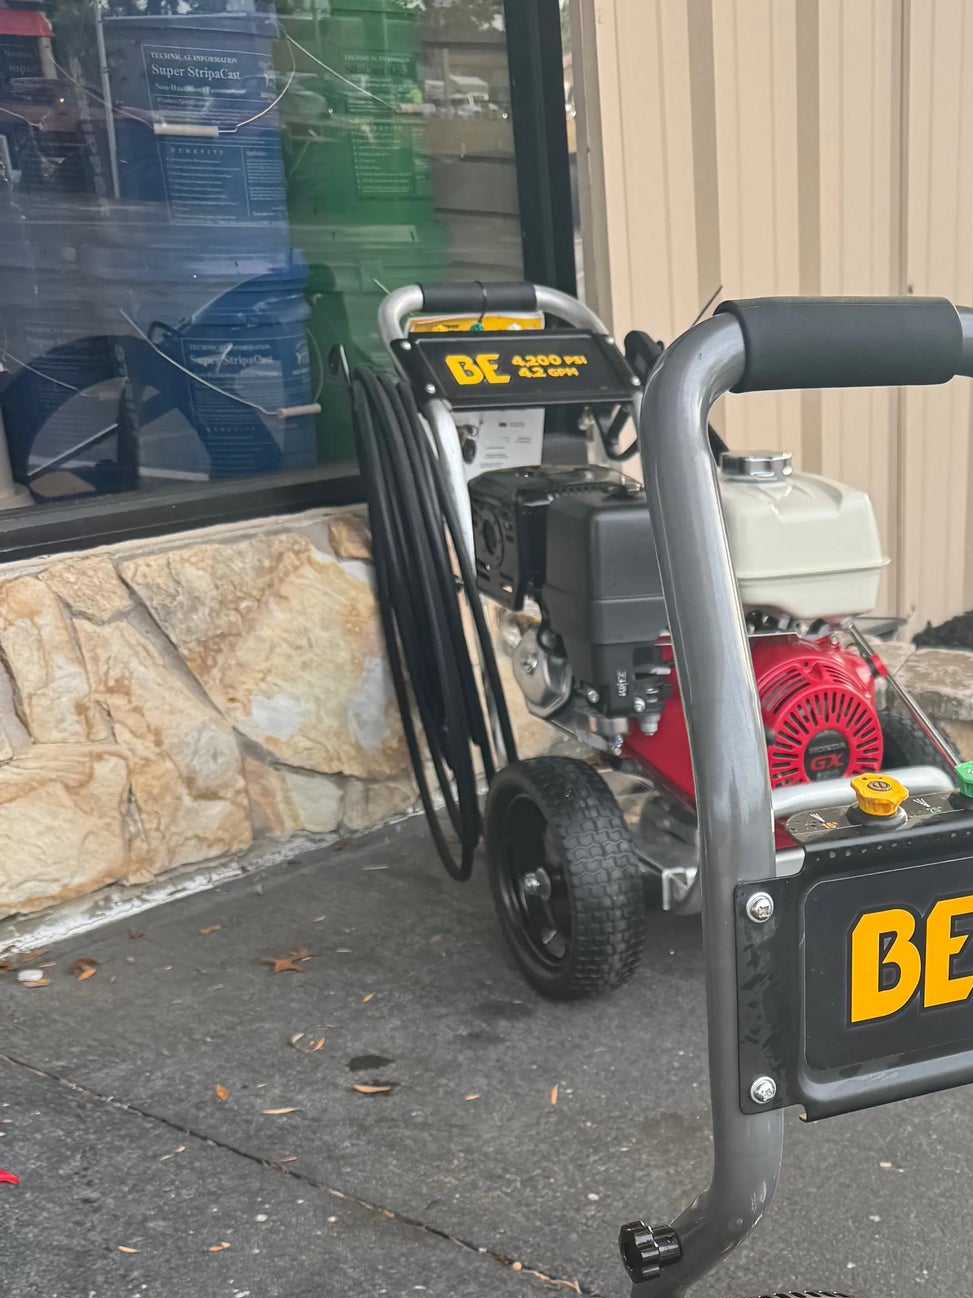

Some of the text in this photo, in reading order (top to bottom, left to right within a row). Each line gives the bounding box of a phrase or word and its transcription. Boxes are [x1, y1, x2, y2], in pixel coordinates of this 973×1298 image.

[151, 63, 241, 81] Super StripaCast
[445, 354, 588, 385] BE 4,200 PSI
[547, 367, 579, 377] GPM
[810, 752, 846, 772] GX
